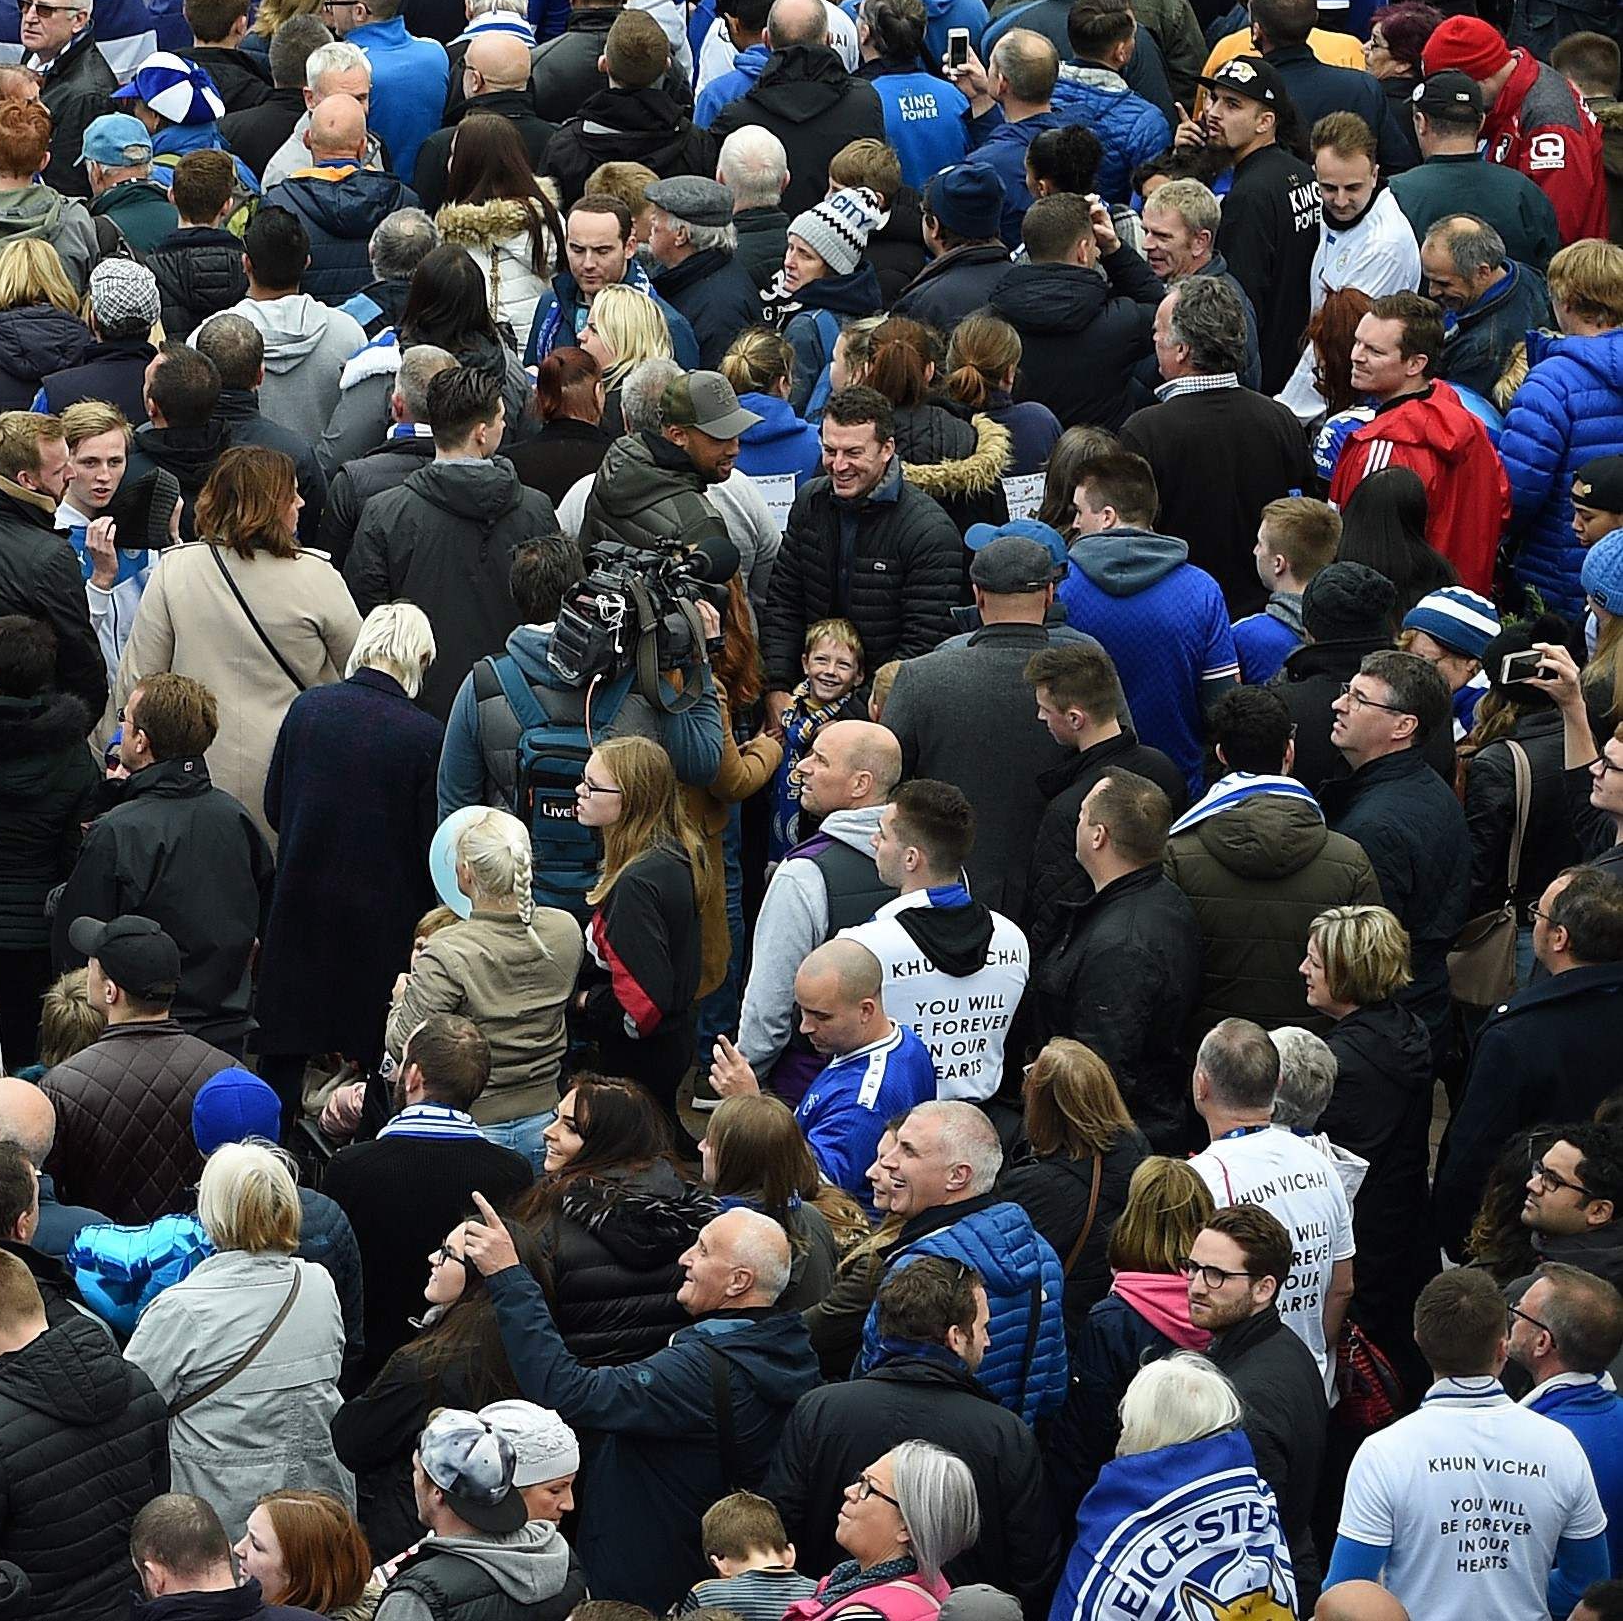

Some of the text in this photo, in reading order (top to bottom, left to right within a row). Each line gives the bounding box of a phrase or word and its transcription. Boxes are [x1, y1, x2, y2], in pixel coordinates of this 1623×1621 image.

[898, 93, 936, 111] KING
[902, 107, 940, 123] POWER
[831, 195, 873, 229] CITY
[1294, 206, 1321, 232] POWE
[891, 960, 934, 979] KHU
[915, 993, 1006, 1018] YOU WILL
[932, 1015, 1009, 1037] FOREVER
[953, 1038, 987, 1057] OUR
[933, 1060, 982, 1081] EARTS
[1278, 1170, 1328, 1194] VICHAI
[1297, 1220, 1328, 1242] WILL
[1428, 1457, 1547, 1479] KHUN VICHAI
[1450, 1497, 1527, 1517] YOU WILL
[1440, 1519, 1533, 1536] BE FOREVER
[1458, 1538, 1510, 1554] IN OUR
[1113, 1498, 1271, 1620] EICESTE
[1456, 1556, 1509, 1574] HEARTS
